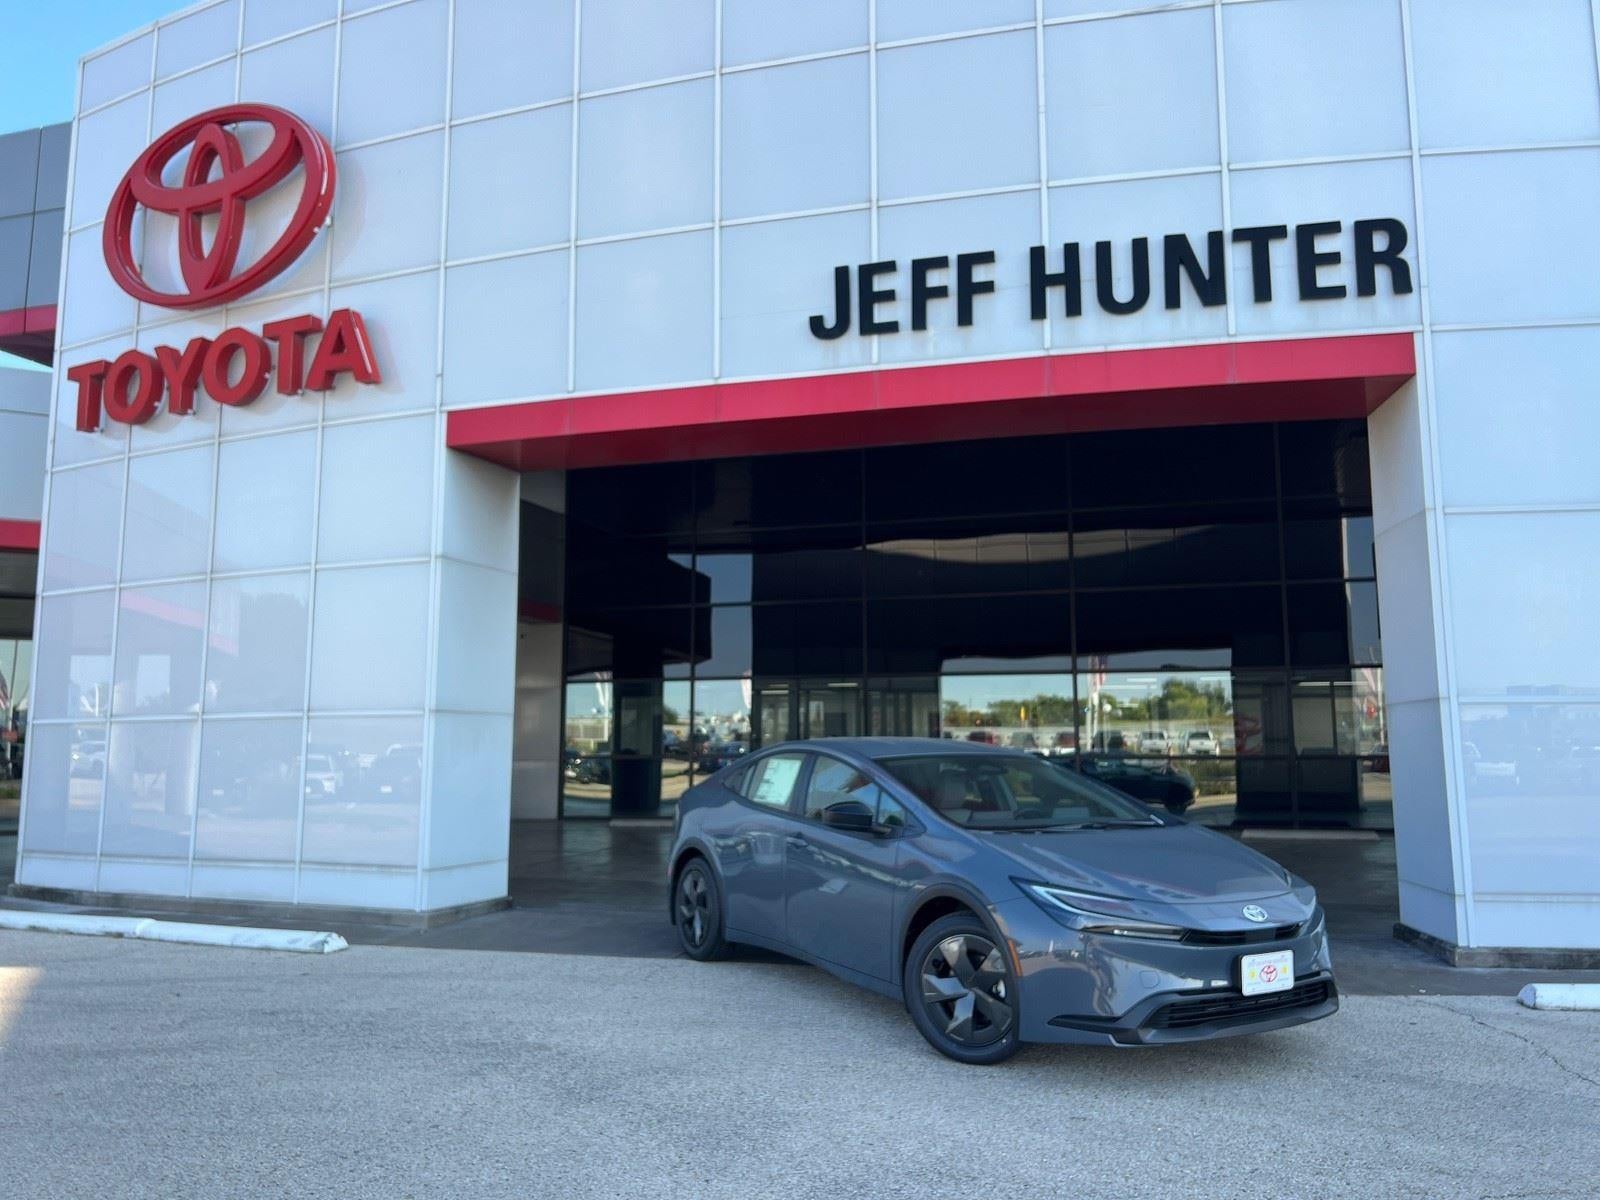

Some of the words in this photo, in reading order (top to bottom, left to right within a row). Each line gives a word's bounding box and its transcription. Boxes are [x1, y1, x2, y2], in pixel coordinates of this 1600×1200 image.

[809, 250, 995, 340] JEFF
[1029, 218, 1413, 320] HUNTER
[67, 308, 381, 432] TOYOTA
